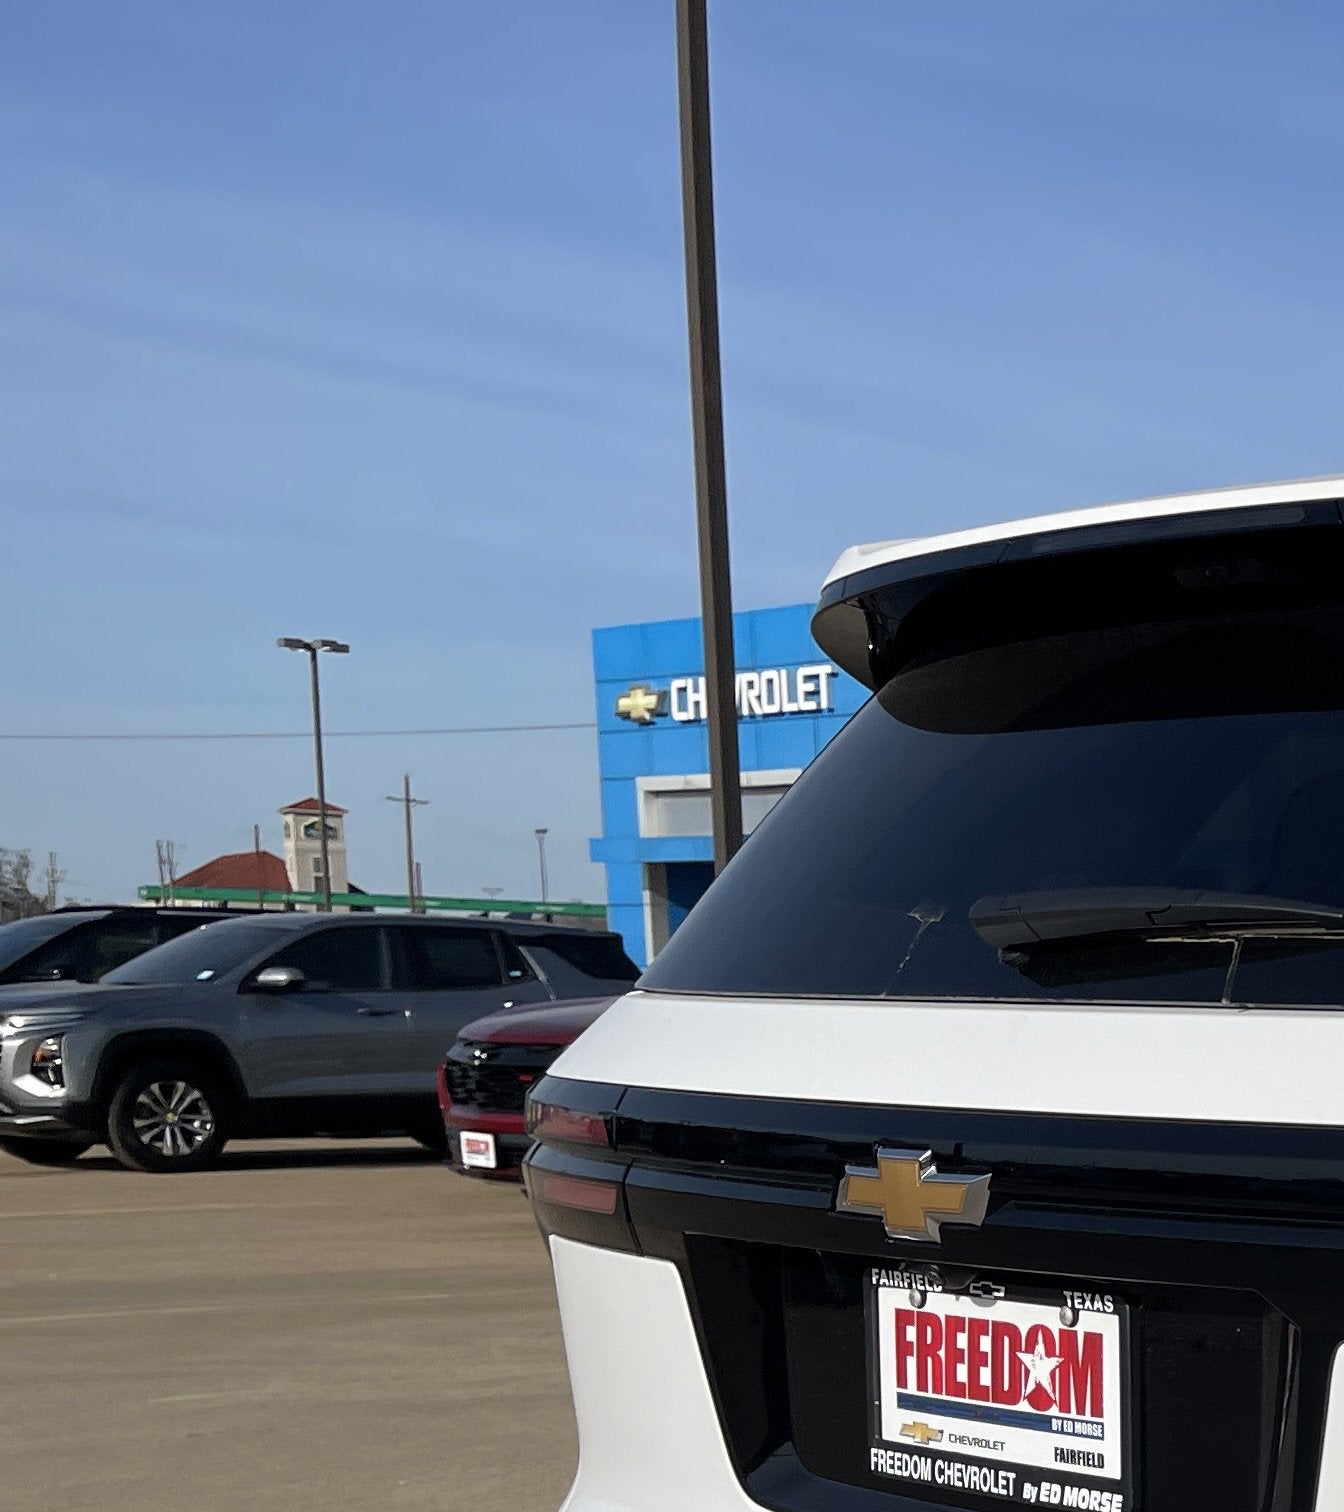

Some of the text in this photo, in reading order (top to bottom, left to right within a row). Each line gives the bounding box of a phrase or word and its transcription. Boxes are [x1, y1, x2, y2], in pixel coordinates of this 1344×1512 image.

[670, 664, 832, 722] CHROLET
[1063, 1290, 1114, 1313] TEXAS
[894, 1308, 1104, 1418] FREEDOM
[1051, 1417, 1103, 1438] BY ED MORSE
[948, 1433, 1006, 1452] CHEVROLET
[1053, 1446, 1105, 1469] FAIRFIELD
[870, 1447, 931, 1481] FREEDOM
[934, 1459, 1016, 1497] CHEVROLET
[1022, 1482, 1038, 1503] By
[1039, 1481, 1061, 1505] ED
